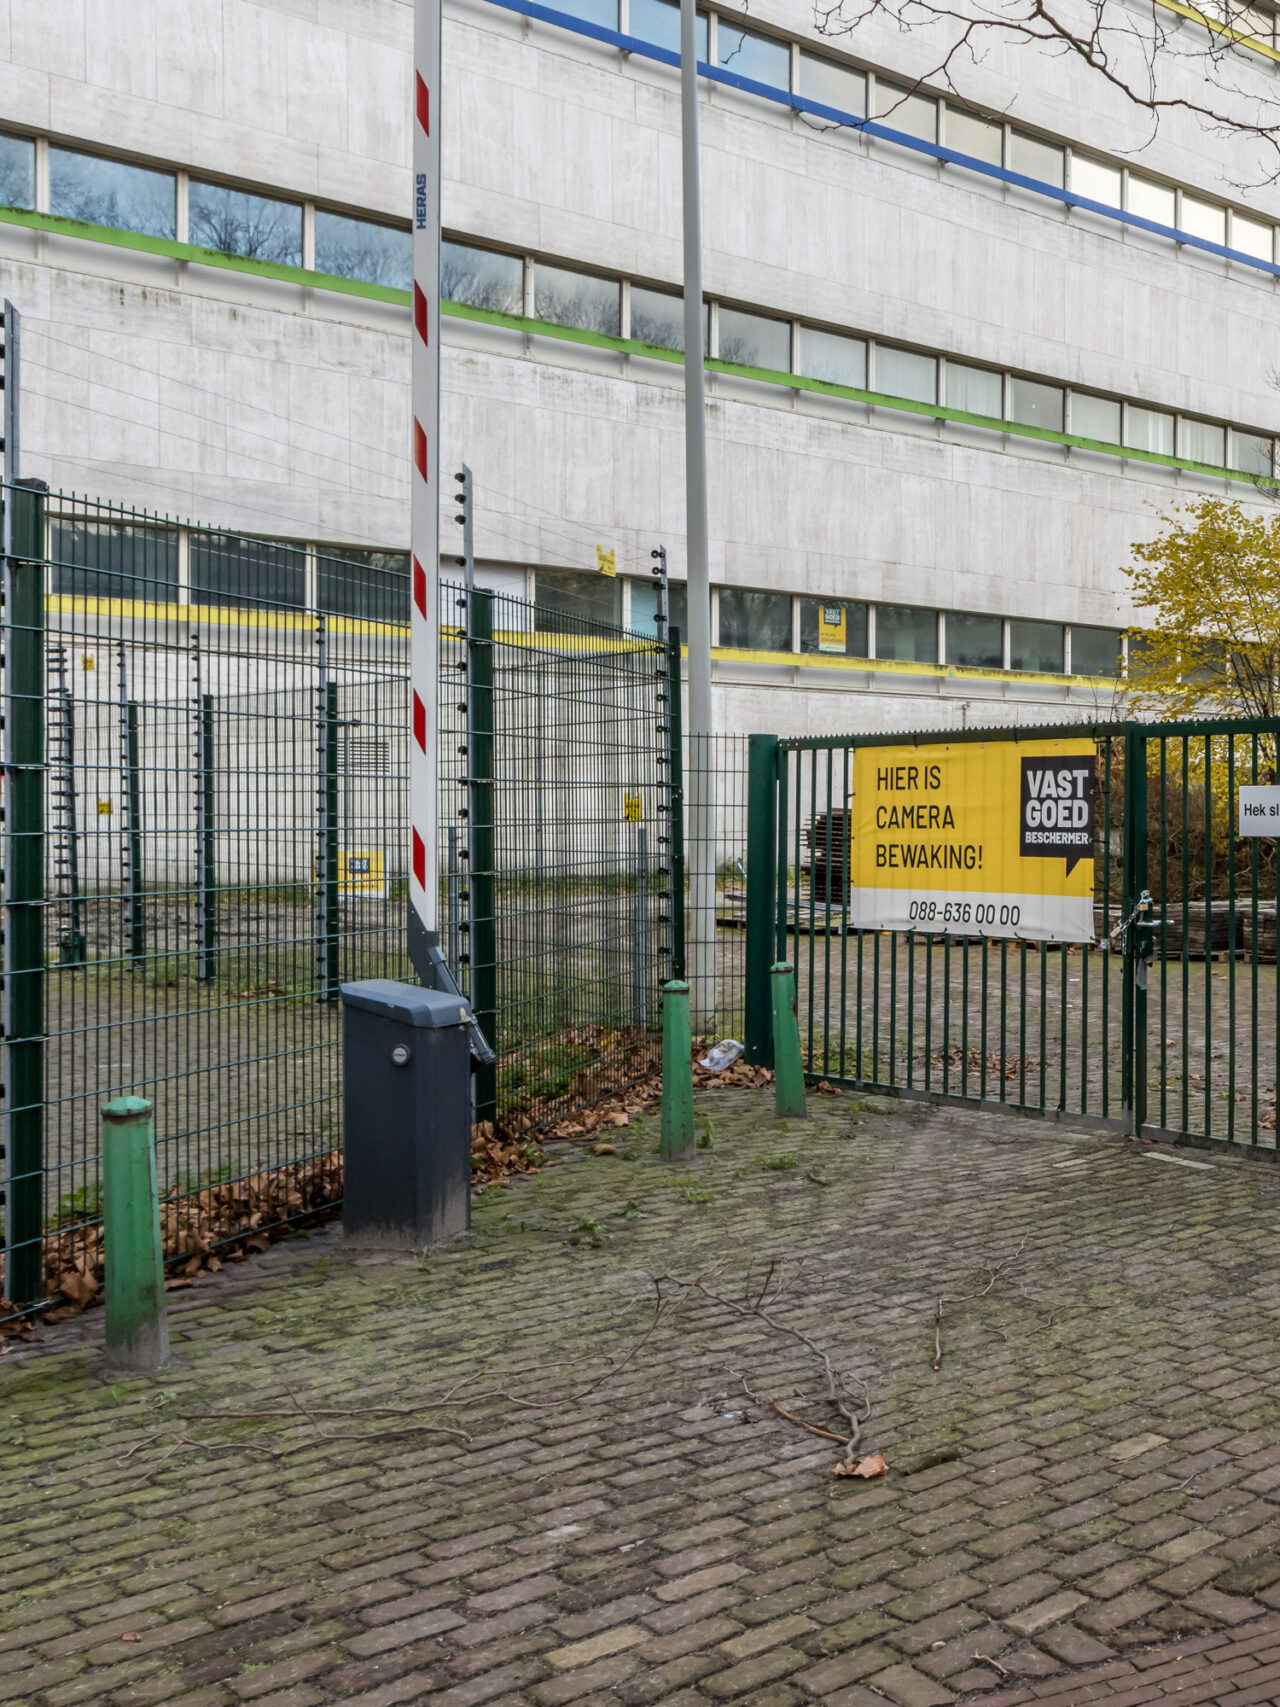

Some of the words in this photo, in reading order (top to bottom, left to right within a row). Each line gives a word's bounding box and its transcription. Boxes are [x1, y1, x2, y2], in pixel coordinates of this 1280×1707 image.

[416, 173, 427, 230] HERAS
[877, 766, 918, 791] HIER
[924, 765, 941, 790] IS
[1026, 769, 1089, 799] VAST
[876, 805, 955, 829] CAMERA
[1025, 800, 1089, 828] GOED
[1244, 803, 1266, 816] Hek
[1025, 831, 1089, 845] BESCHERMER
[875, 844, 983, 870] BEWAKING!
[909, 901, 971, 923] 088-636
[975, 904, 995, 925] 00
[1000, 905, 1020, 926] 00
